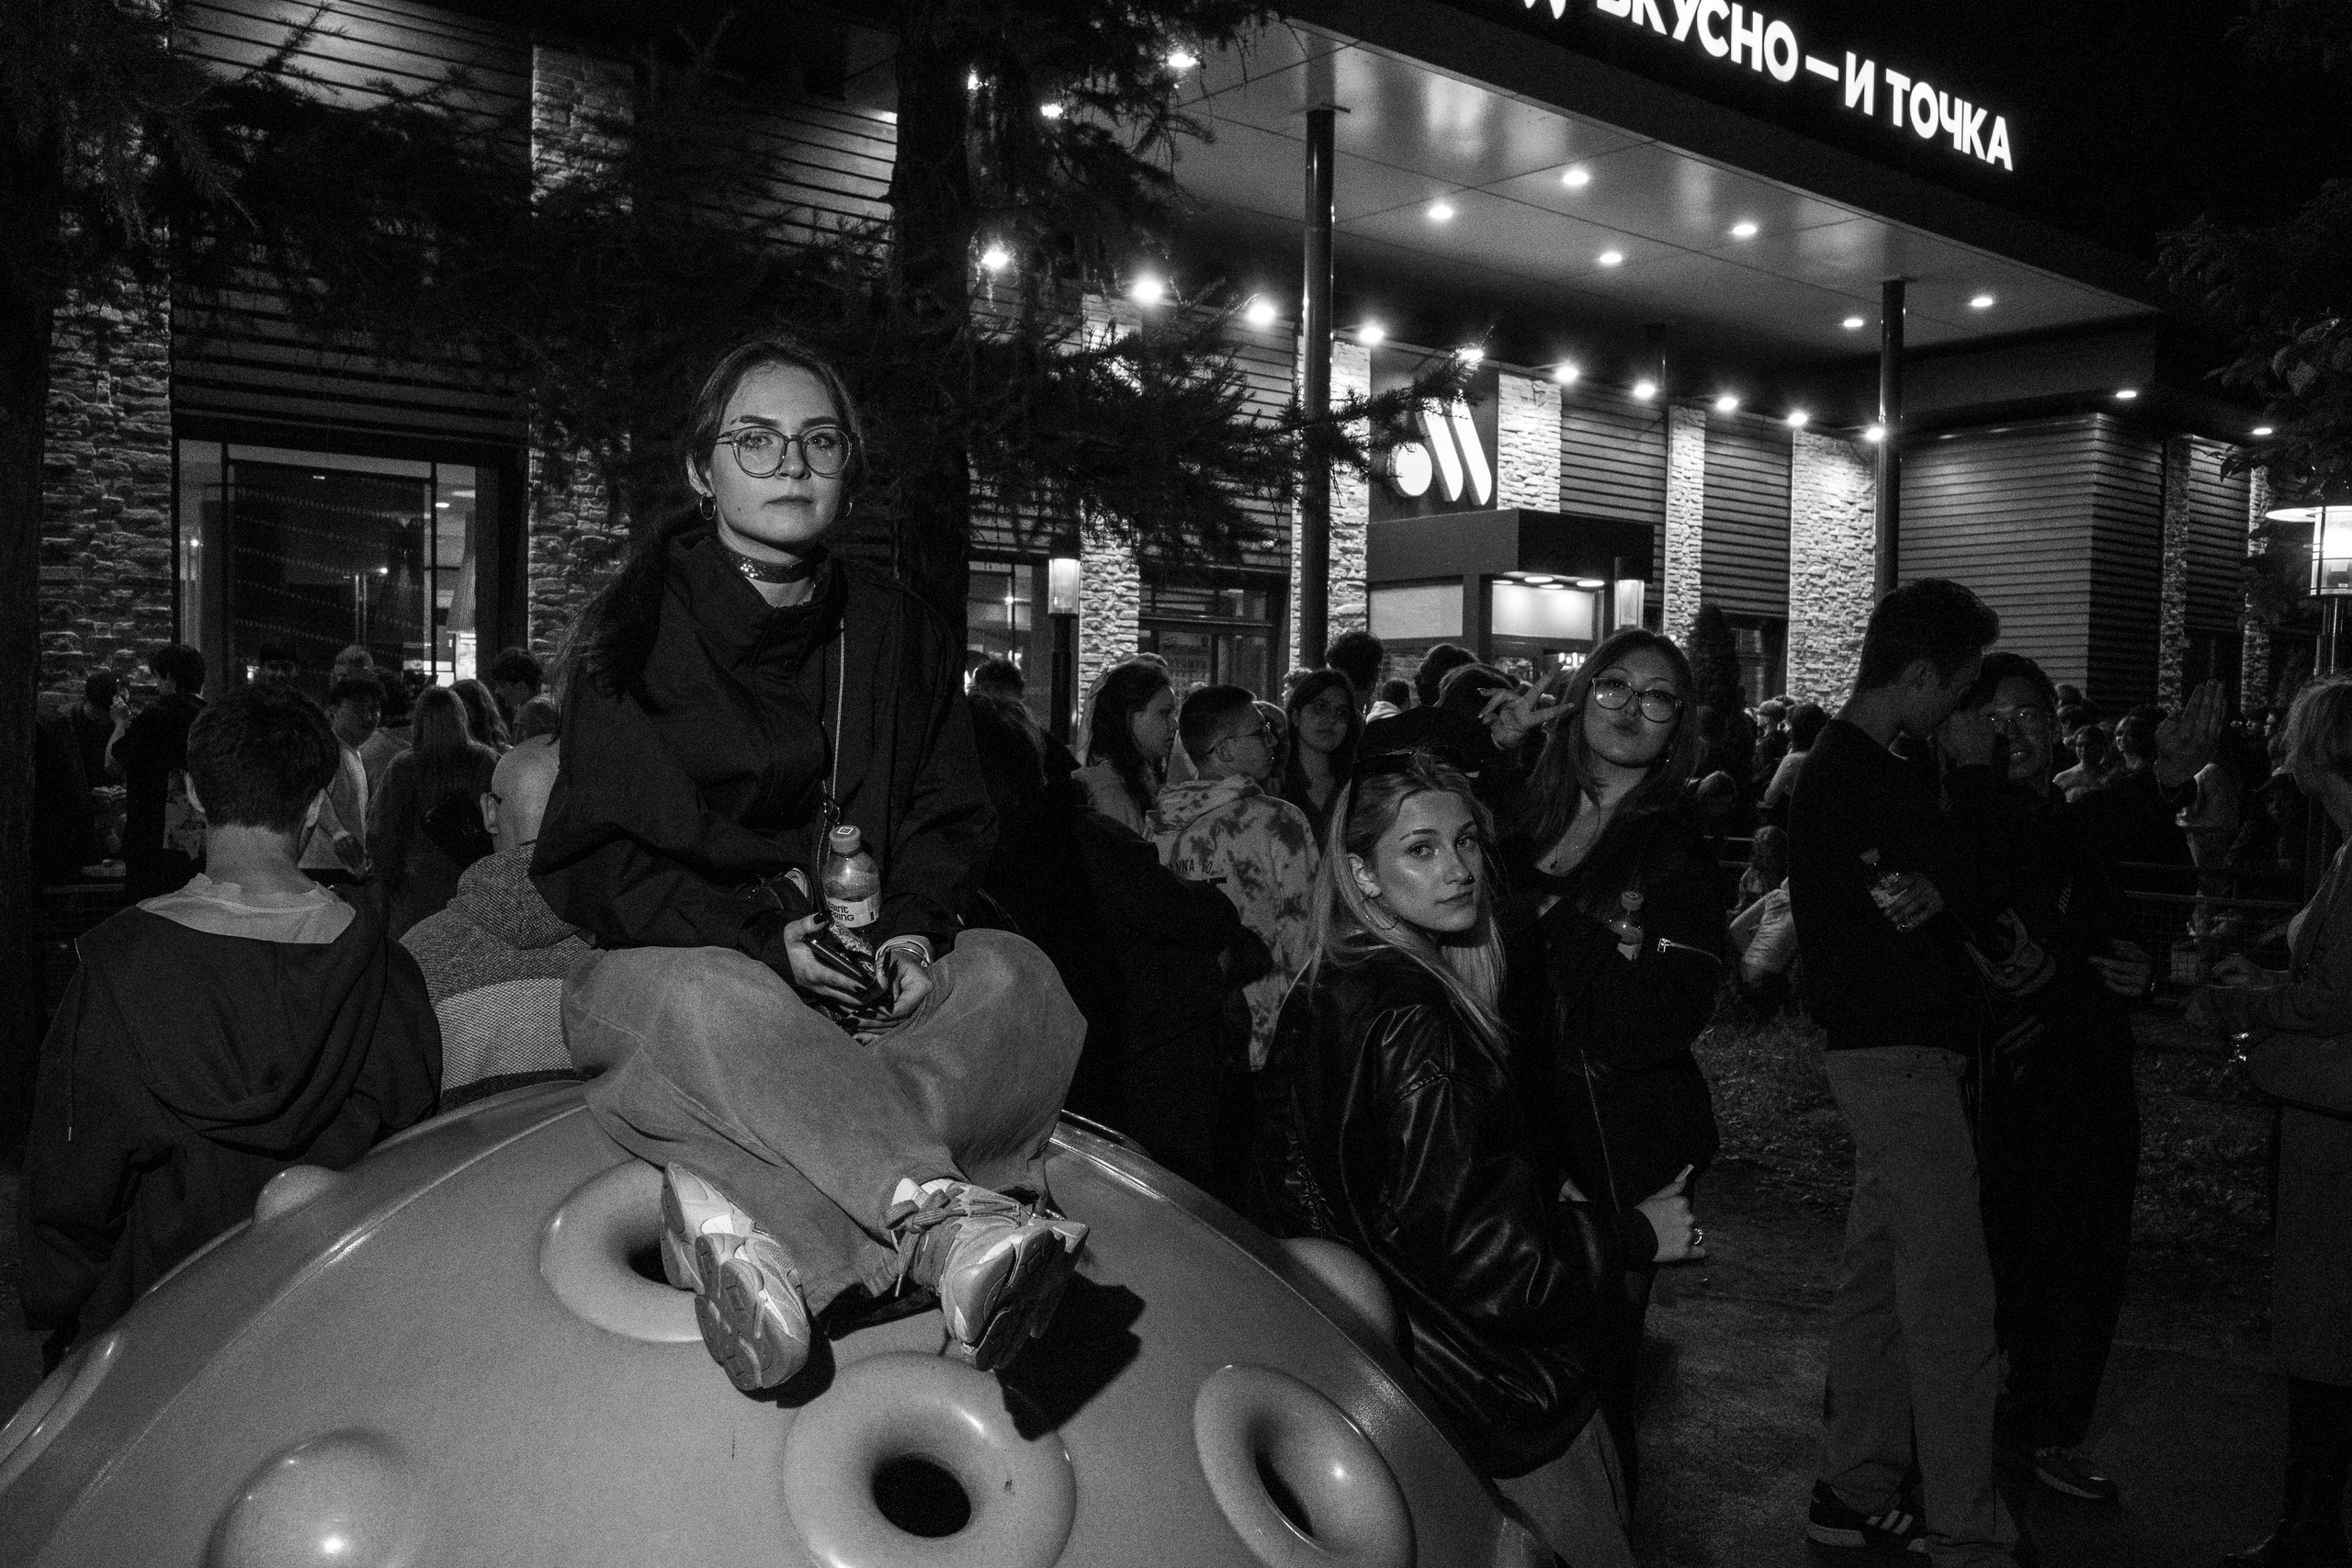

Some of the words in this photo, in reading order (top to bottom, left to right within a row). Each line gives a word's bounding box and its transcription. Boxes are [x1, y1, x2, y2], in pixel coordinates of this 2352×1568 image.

[1597, 0, 1798, 82] УСНО
[1846, 51, 1874, 116] И
[1886, 69, 2012, 171] ТОЧКА
